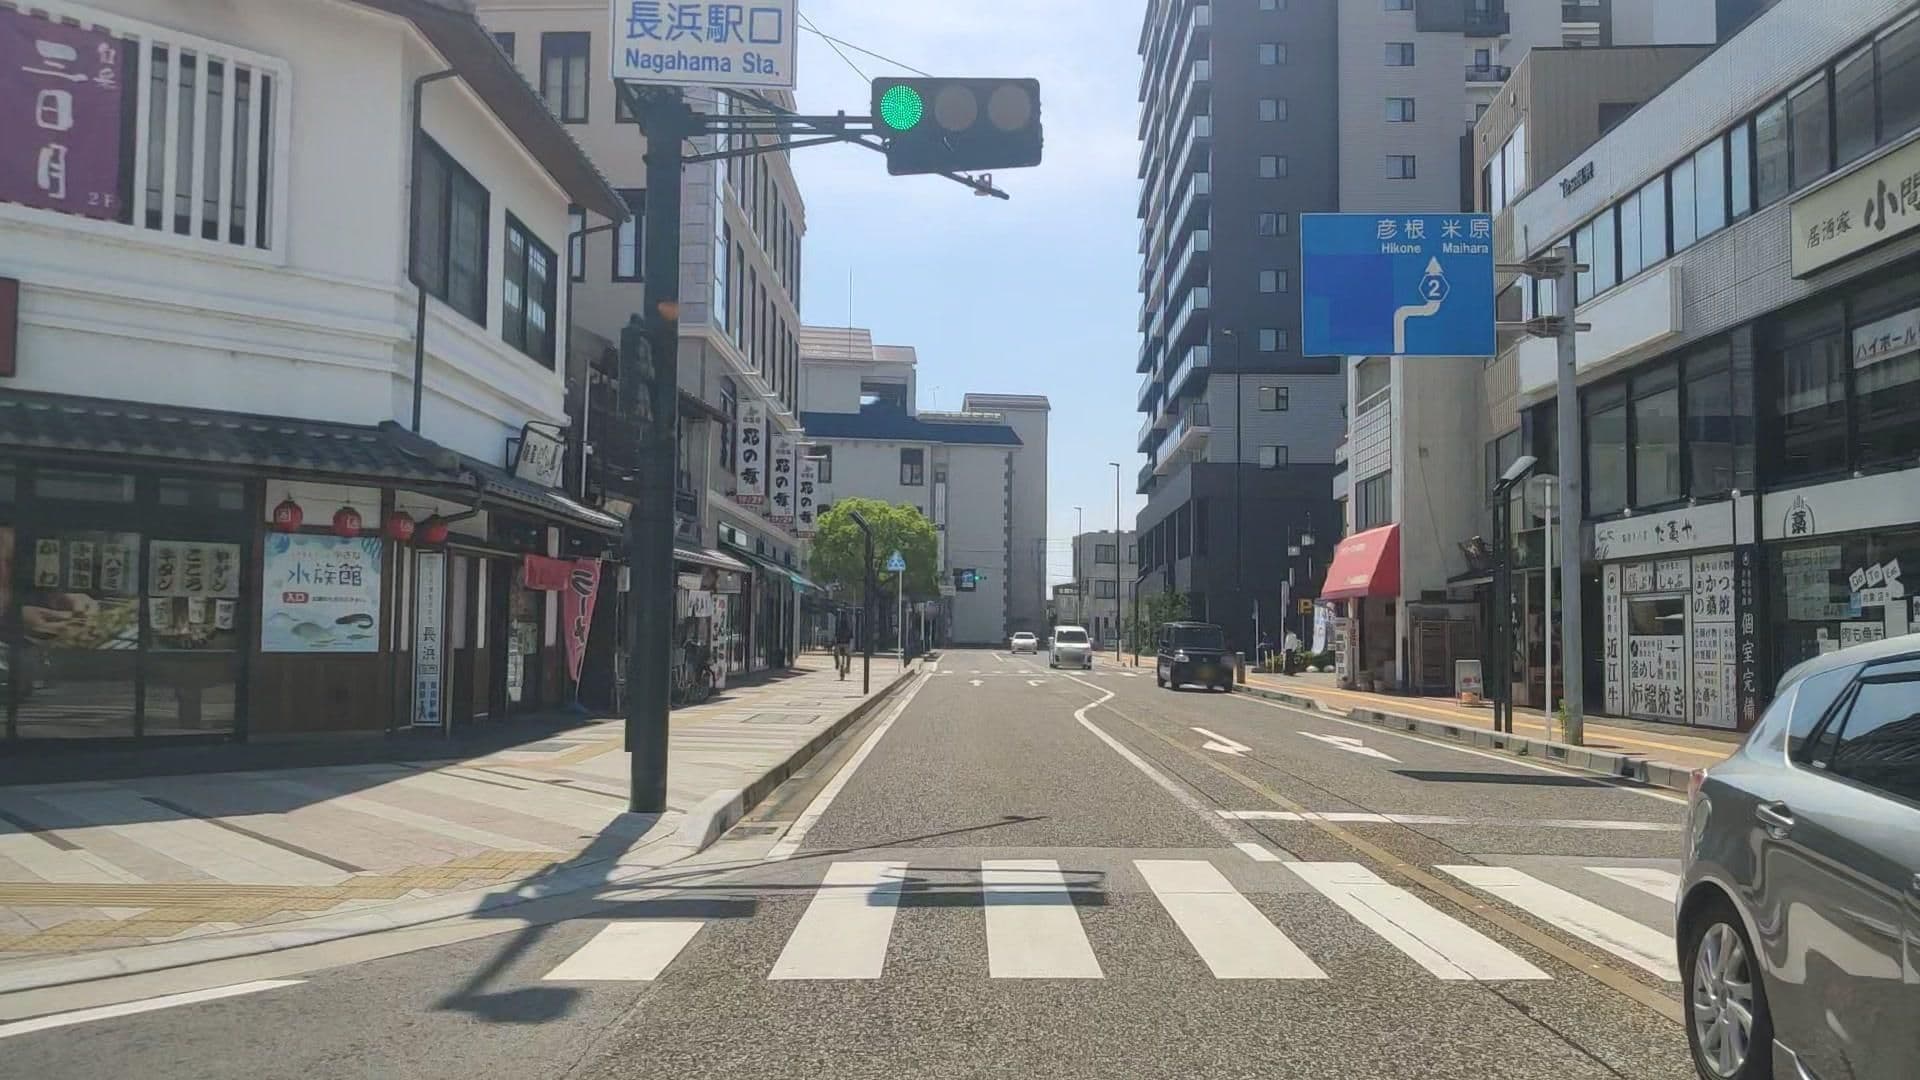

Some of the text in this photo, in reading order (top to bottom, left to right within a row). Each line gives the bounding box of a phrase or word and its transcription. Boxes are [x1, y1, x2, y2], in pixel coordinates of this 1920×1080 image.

[625, 1, 783, 44] 長浜駅口
[625, 48, 780, 76] Nagahama Sta.
[22, 39, 89, 199] 三日月
[1376, 218, 1490, 240] 彦根 米原
[1381, 243, 1489, 254] Hikone Maihara
[1428, 280, 1441, 297] 2
[1855, 319, 1920, 361] ハイボール
[288, 561, 363, 586] 水族館
[285, 592, 306, 602] 入口
[423, 626, 437, 661] 長浜
[1607, 637, 1618, 708] 近江牛
[1631, 660, 1656, 679] 釜めし
[1741, 612, 1755, 720] 個室完備
